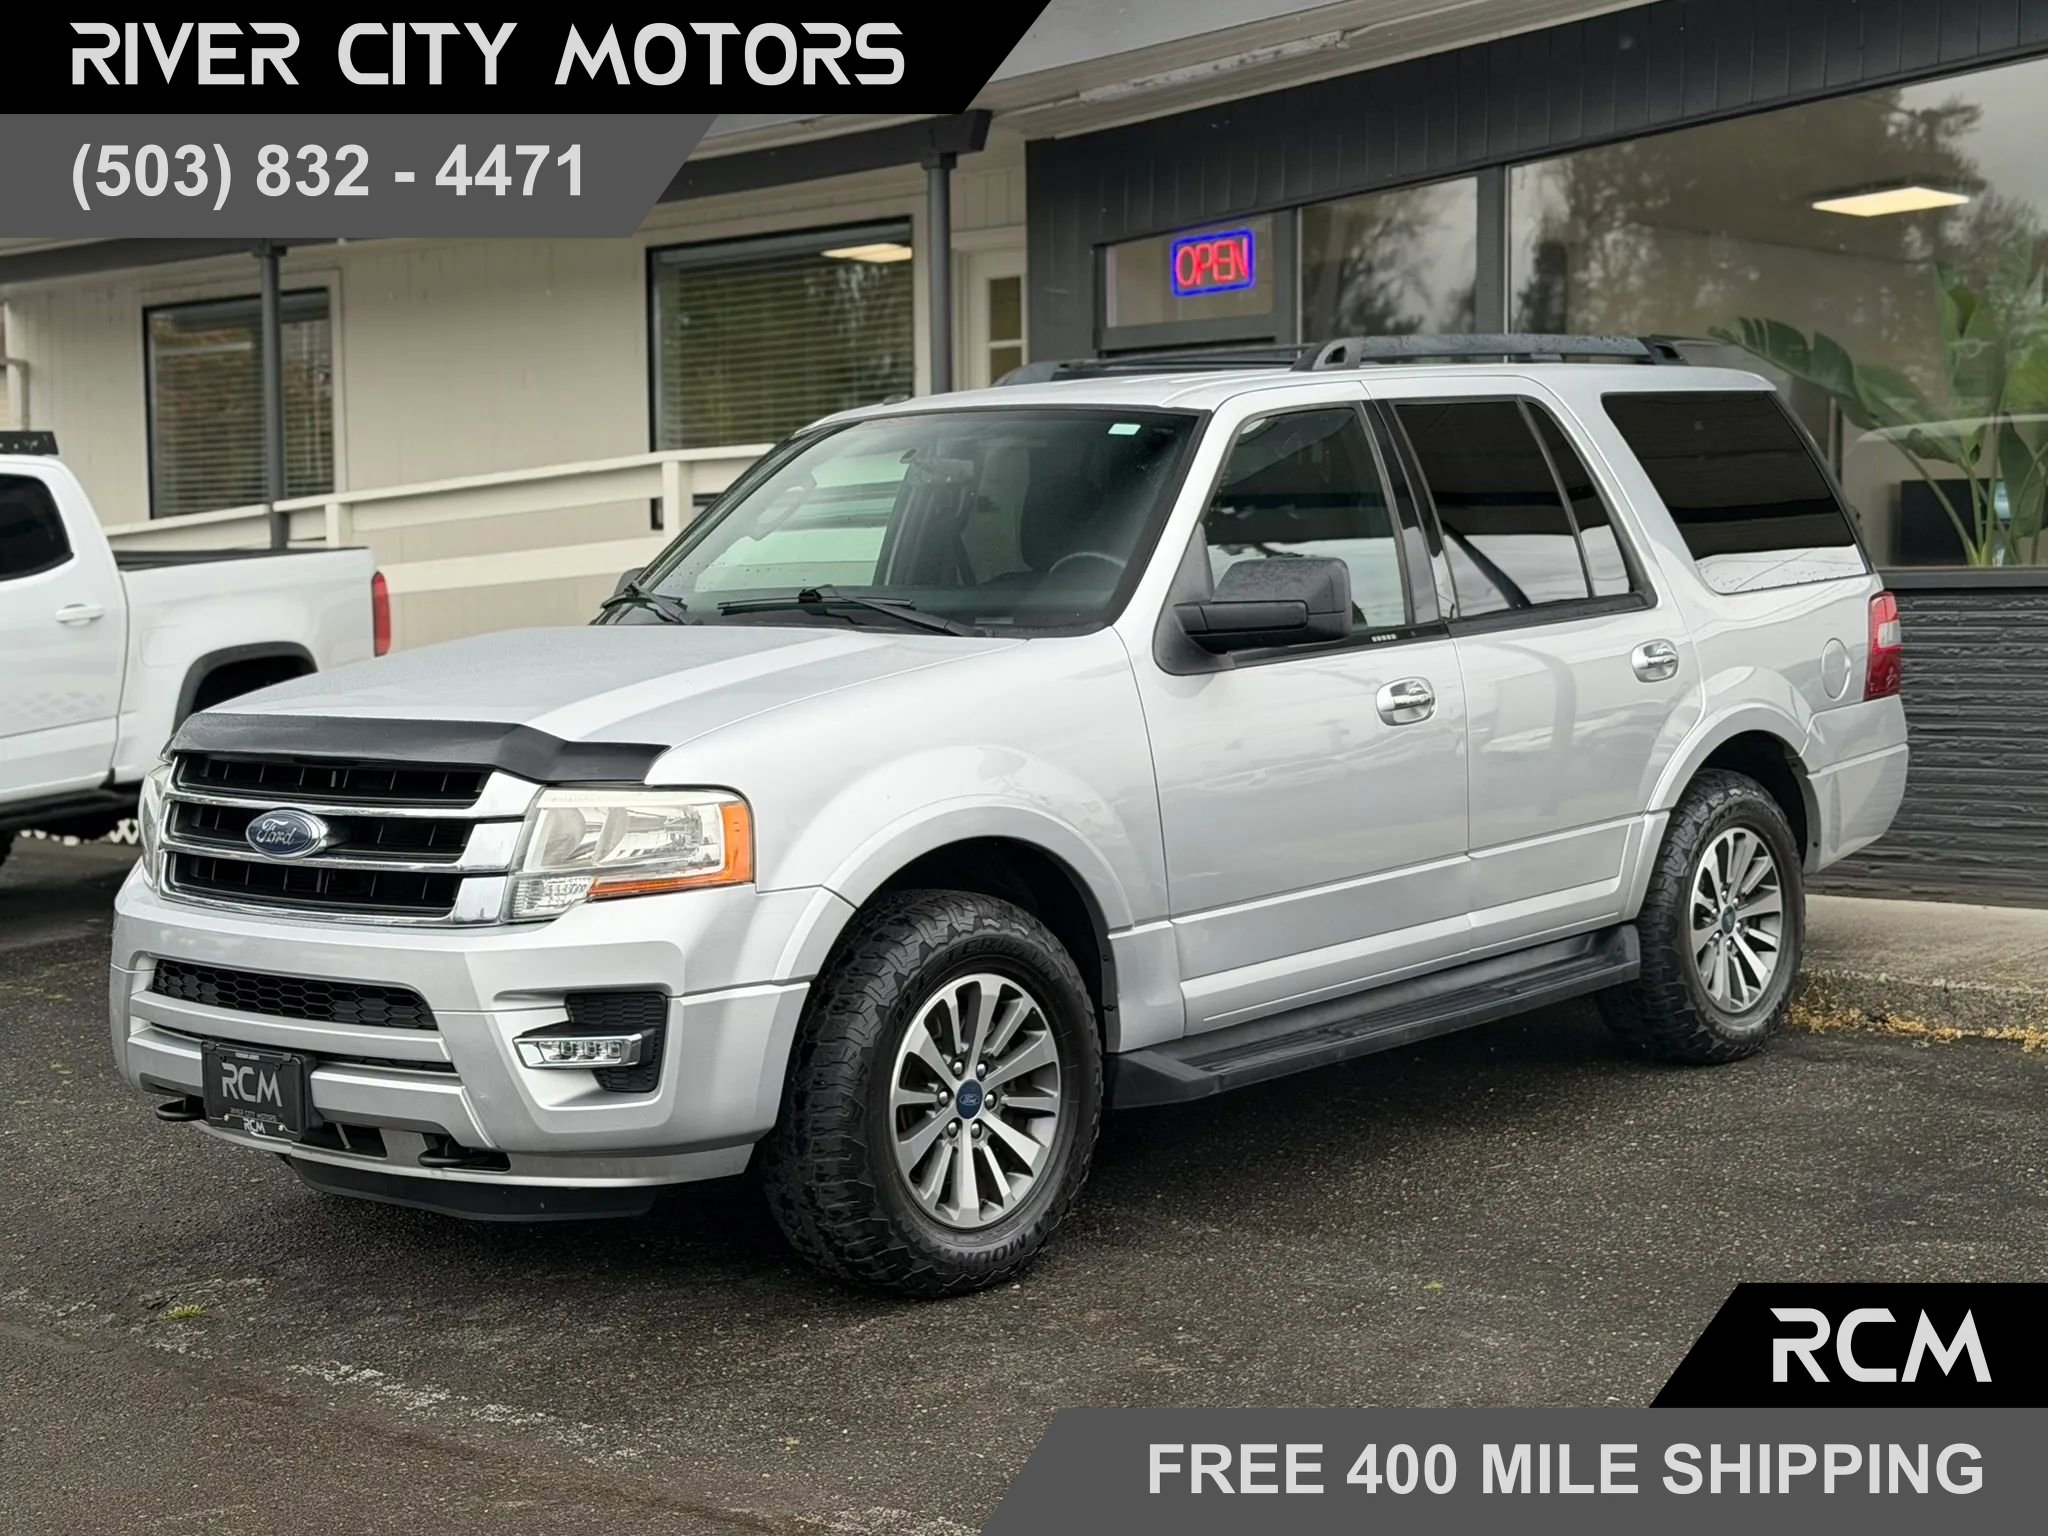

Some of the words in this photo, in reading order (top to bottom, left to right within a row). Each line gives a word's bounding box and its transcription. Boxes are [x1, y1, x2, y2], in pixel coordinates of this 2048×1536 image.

[1176, 237, 1249, 288] OPEN
[256, 818, 297, 845] Ford
[221, 1062, 283, 1107] RCM
[242, 1117, 266, 1134] RCM
